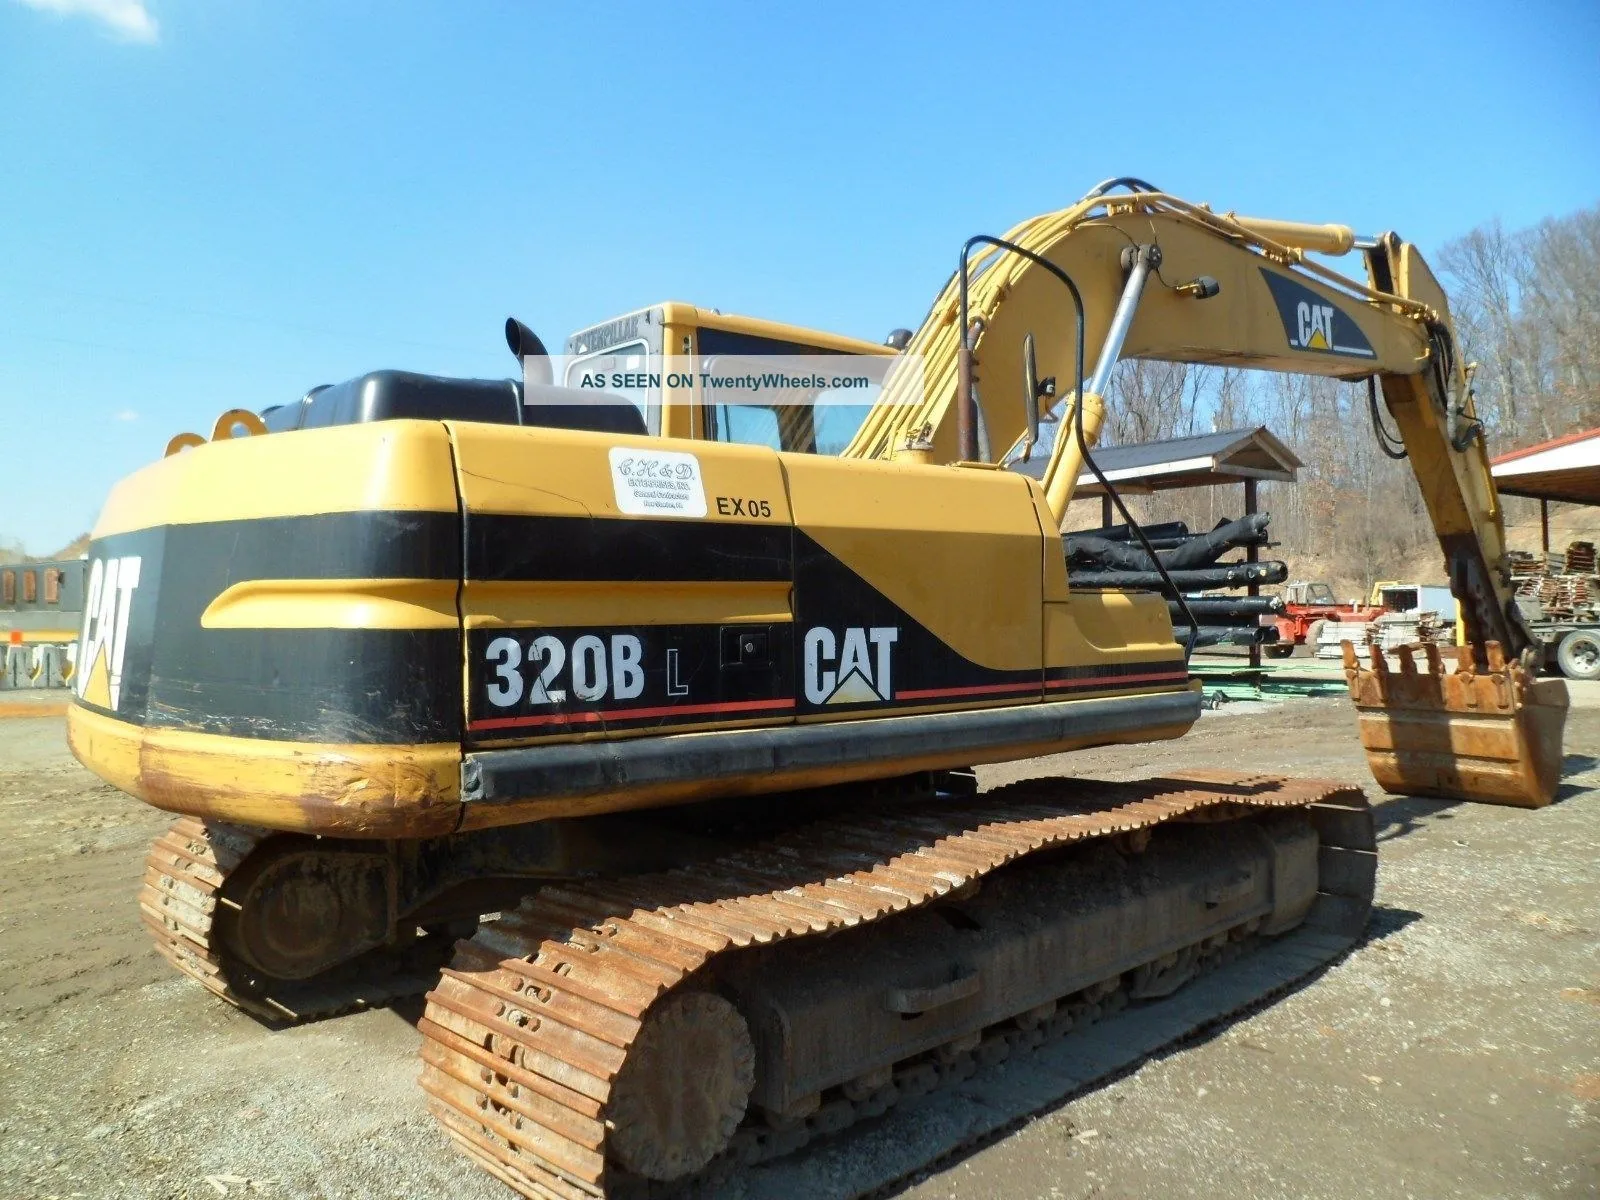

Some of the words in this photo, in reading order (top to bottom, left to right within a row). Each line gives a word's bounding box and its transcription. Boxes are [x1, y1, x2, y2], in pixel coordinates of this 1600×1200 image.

[1297, 301, 1334, 350] CAT
[77, 556, 142, 712] CAT
[485, 633, 645, 708] 320B
[667, 648, 689, 697] L
[804, 626, 899, 705] CAT
